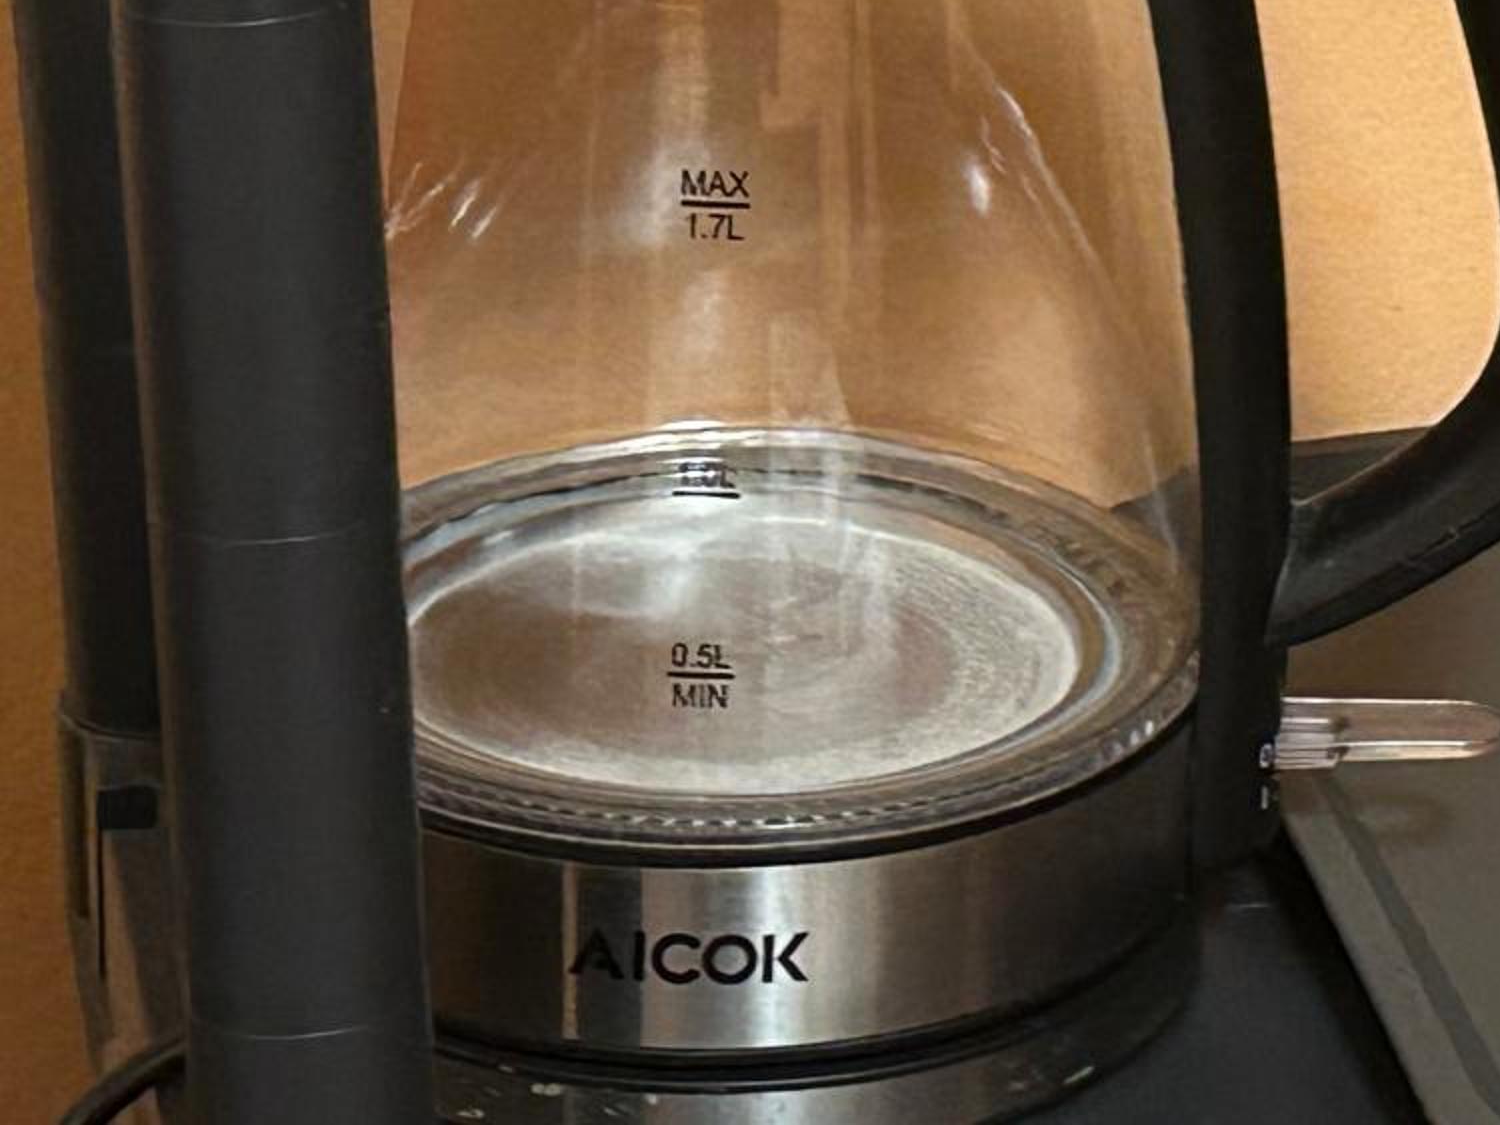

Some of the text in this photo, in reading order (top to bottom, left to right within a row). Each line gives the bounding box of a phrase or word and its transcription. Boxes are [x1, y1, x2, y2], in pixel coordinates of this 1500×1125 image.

[681, 169, 750, 198] MAX
[690, 212, 745, 241] 1.7L
[671, 642, 733, 669] 0.5L
[672, 683, 730, 709] MIN
[567, 929, 809, 986] AICOK
